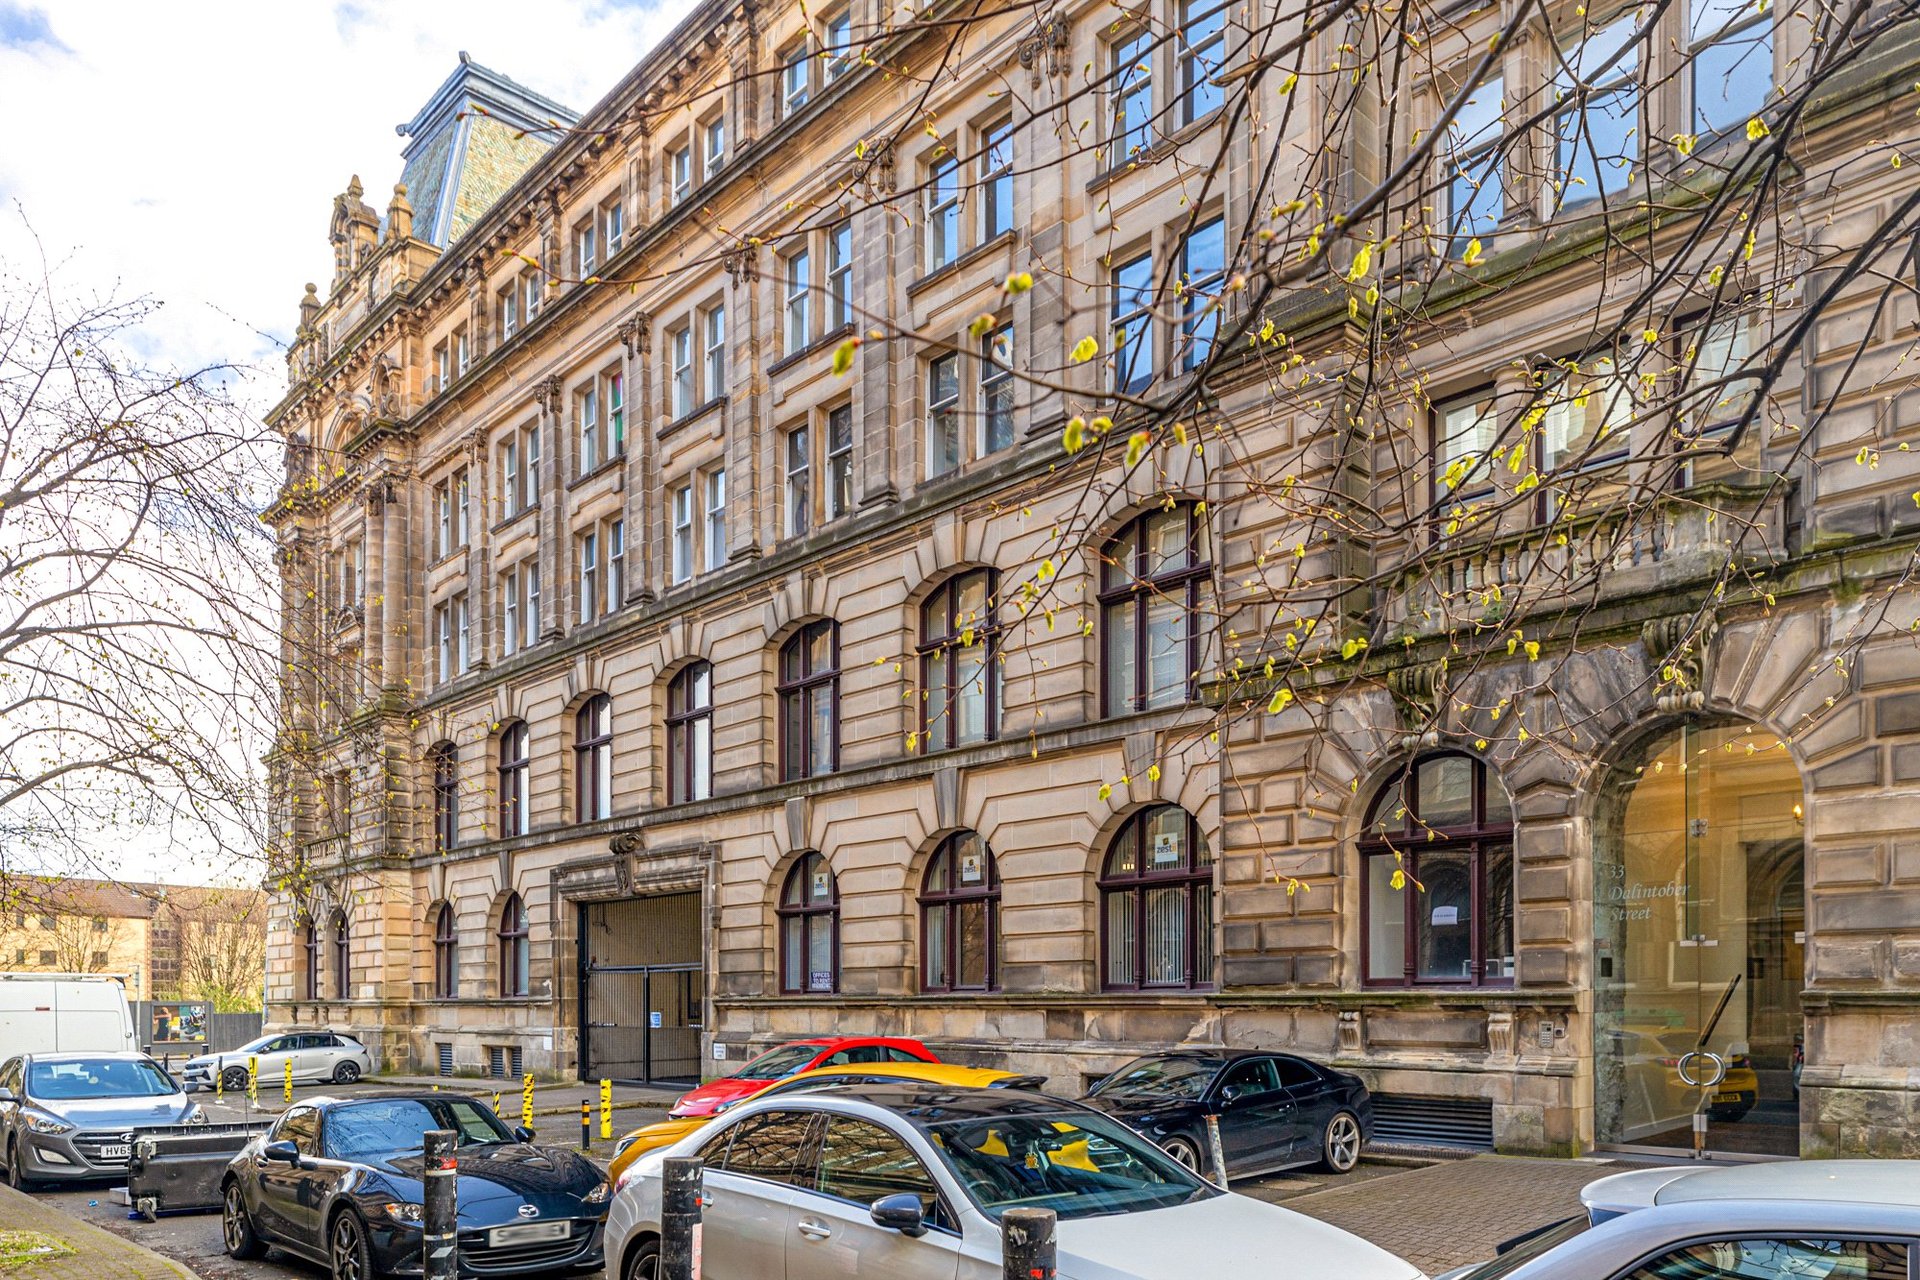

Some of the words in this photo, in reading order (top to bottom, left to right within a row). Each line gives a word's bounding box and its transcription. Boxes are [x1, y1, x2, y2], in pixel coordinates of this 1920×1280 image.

[1610, 864, 1625, 879] 33
[1608, 880, 1691, 901] Dalintober
[1609, 907, 1652, 921] Street
